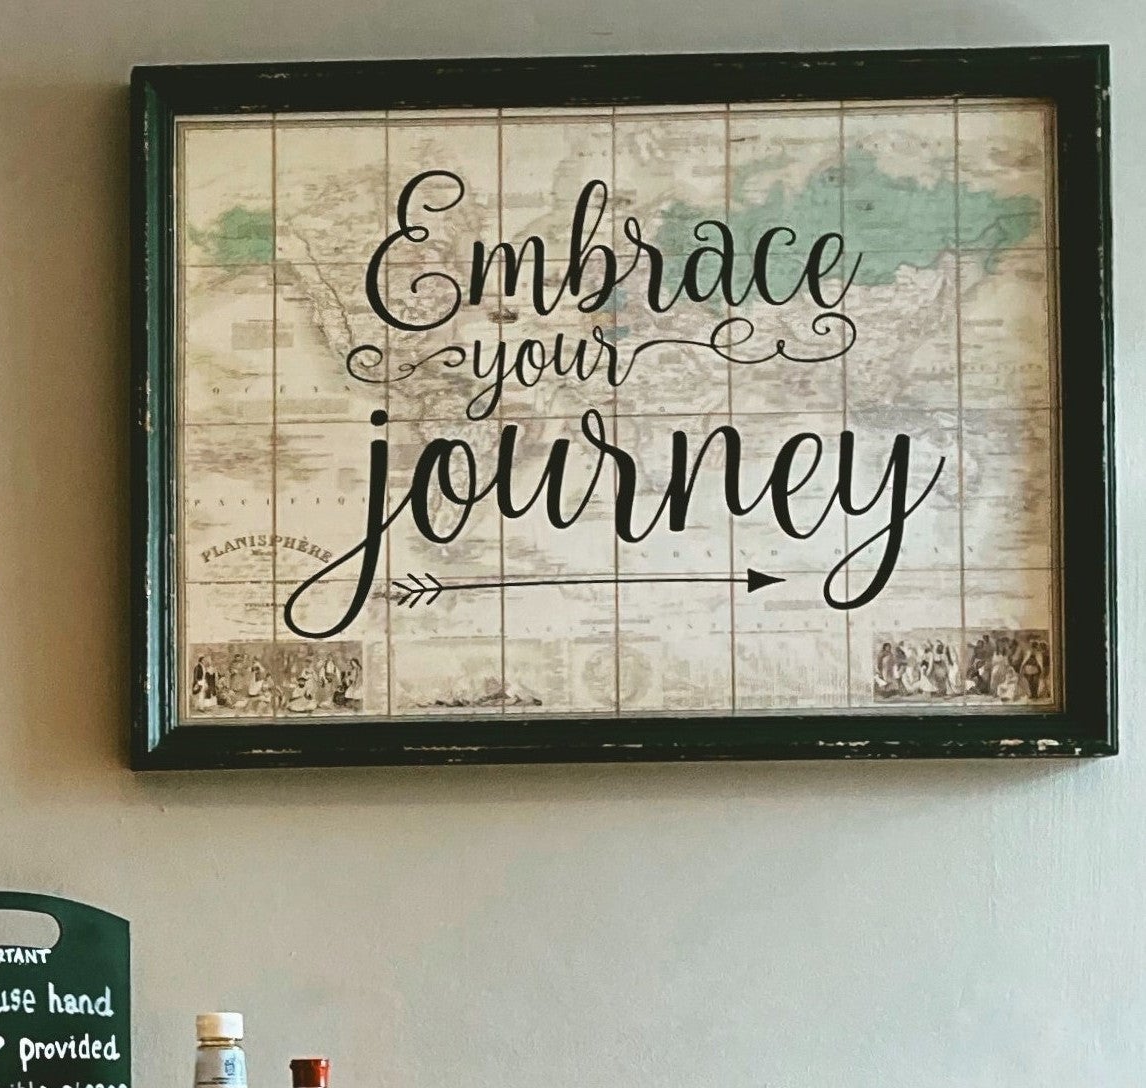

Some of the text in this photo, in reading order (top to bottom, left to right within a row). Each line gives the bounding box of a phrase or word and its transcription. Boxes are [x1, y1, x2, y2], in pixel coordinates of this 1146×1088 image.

[365, 169, 863, 332] Embrace
[466, 325, 637, 421] your
[283, 408, 946, 639] journey
[48, 982, 114, 1018] hand
[19, 1033, 121, 1073] provided
